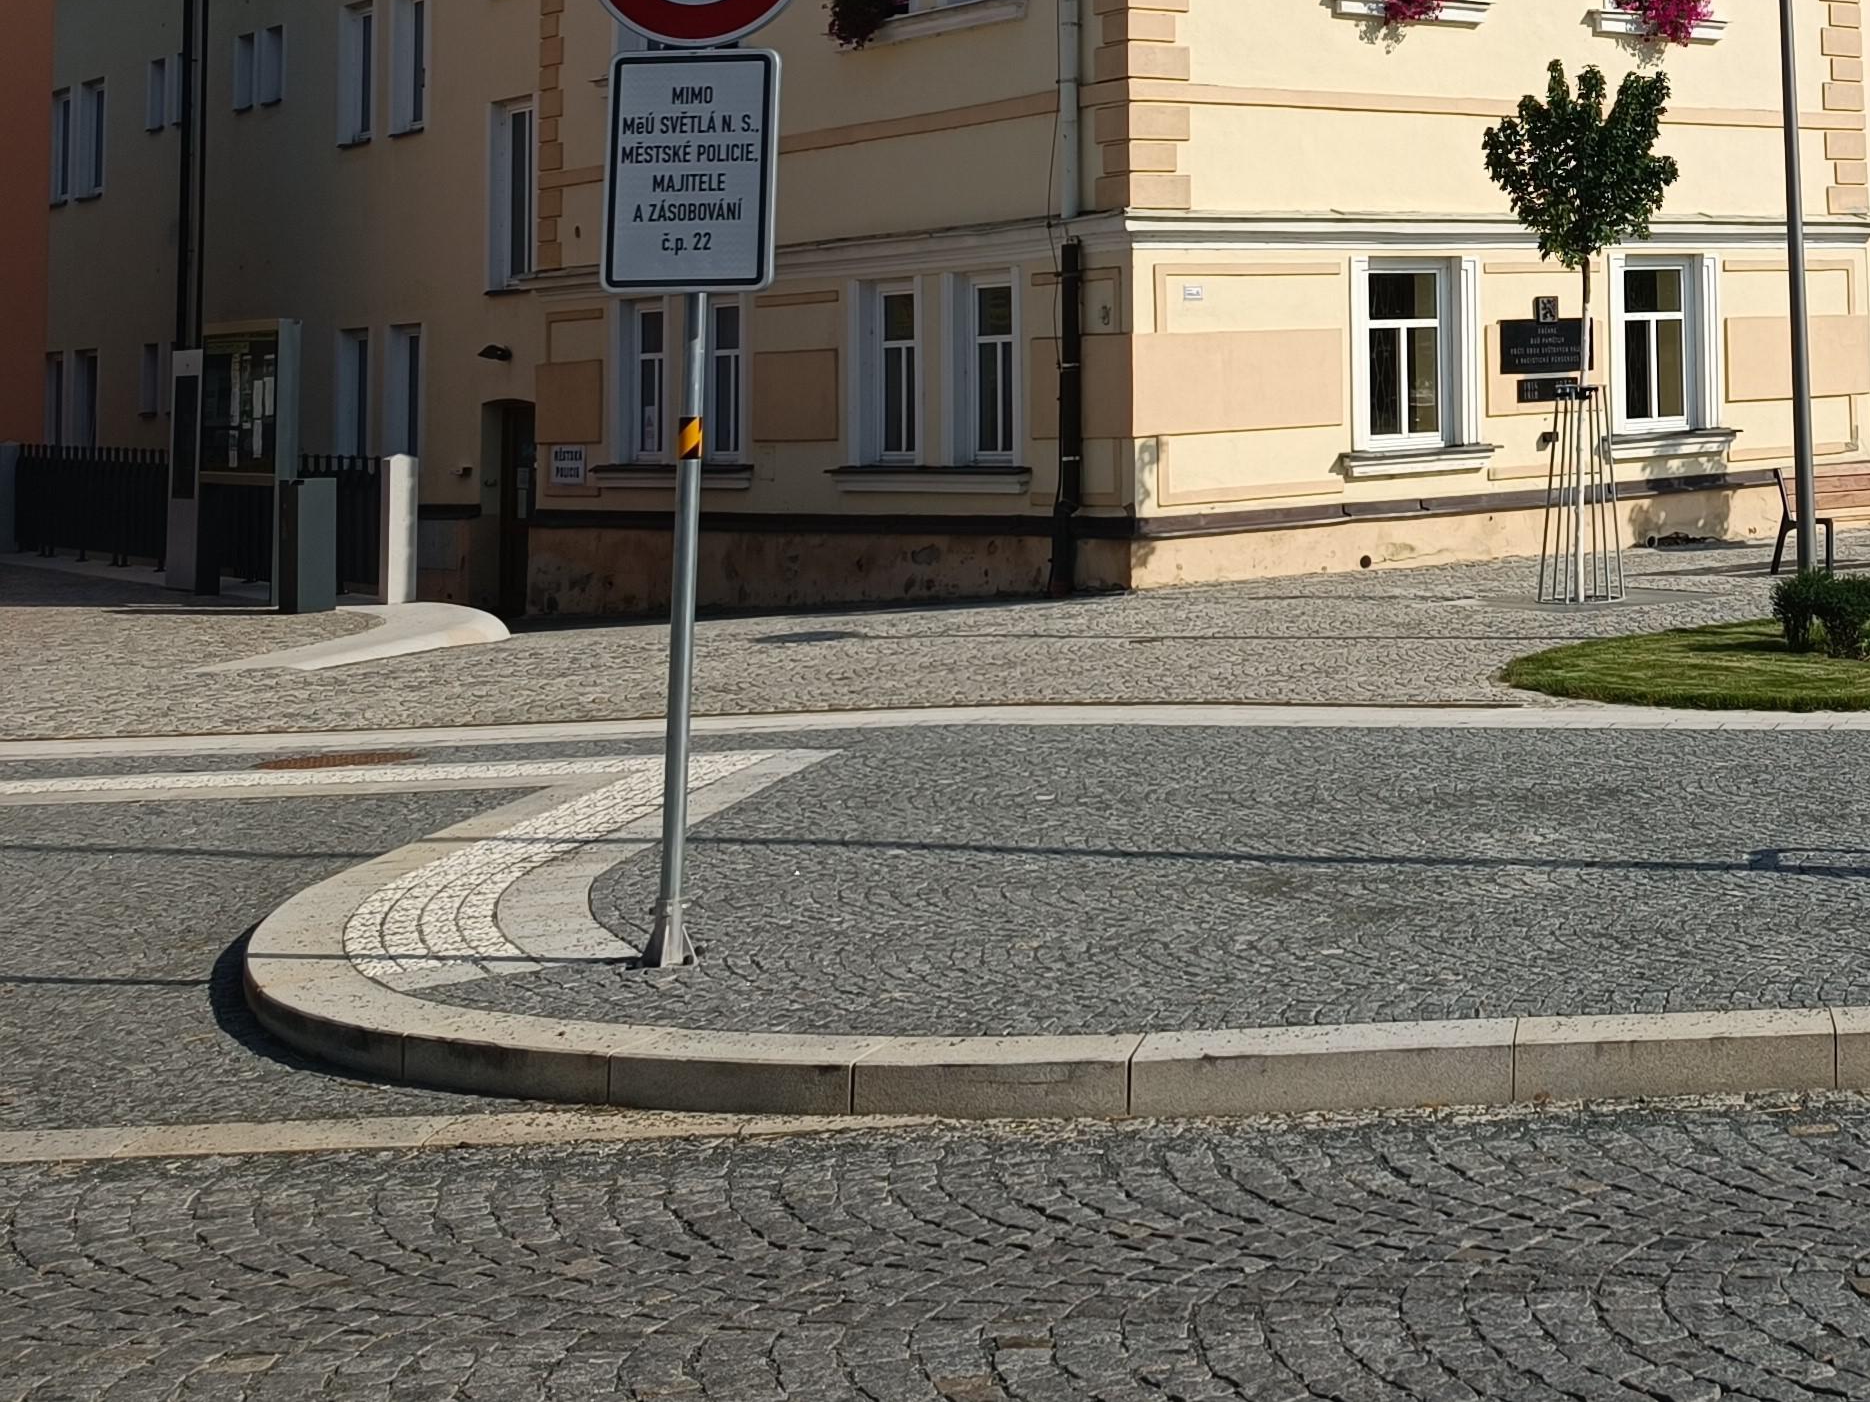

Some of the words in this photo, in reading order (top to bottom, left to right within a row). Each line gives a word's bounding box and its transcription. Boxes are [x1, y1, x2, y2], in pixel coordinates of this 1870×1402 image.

[671, 85, 714, 105] MIMO
[622, 112, 655, 135] MěÚ
[660, 110, 717, 134] SVĚTLÁ
[721, 114, 736, 133] N.
[741, 114, 760, 134] S.,
[621, 140, 692, 164] MĚSTSKÉ
[696, 143, 759, 163] POLICIE,
[652, 173, 726, 193] MAJITELE
[632, 204, 644, 222] A
[647, 198, 743, 222] ZÁSOBOVÁNÍ
[661, 233, 688, 256] č.p.
[693, 232, 712, 251] 22
